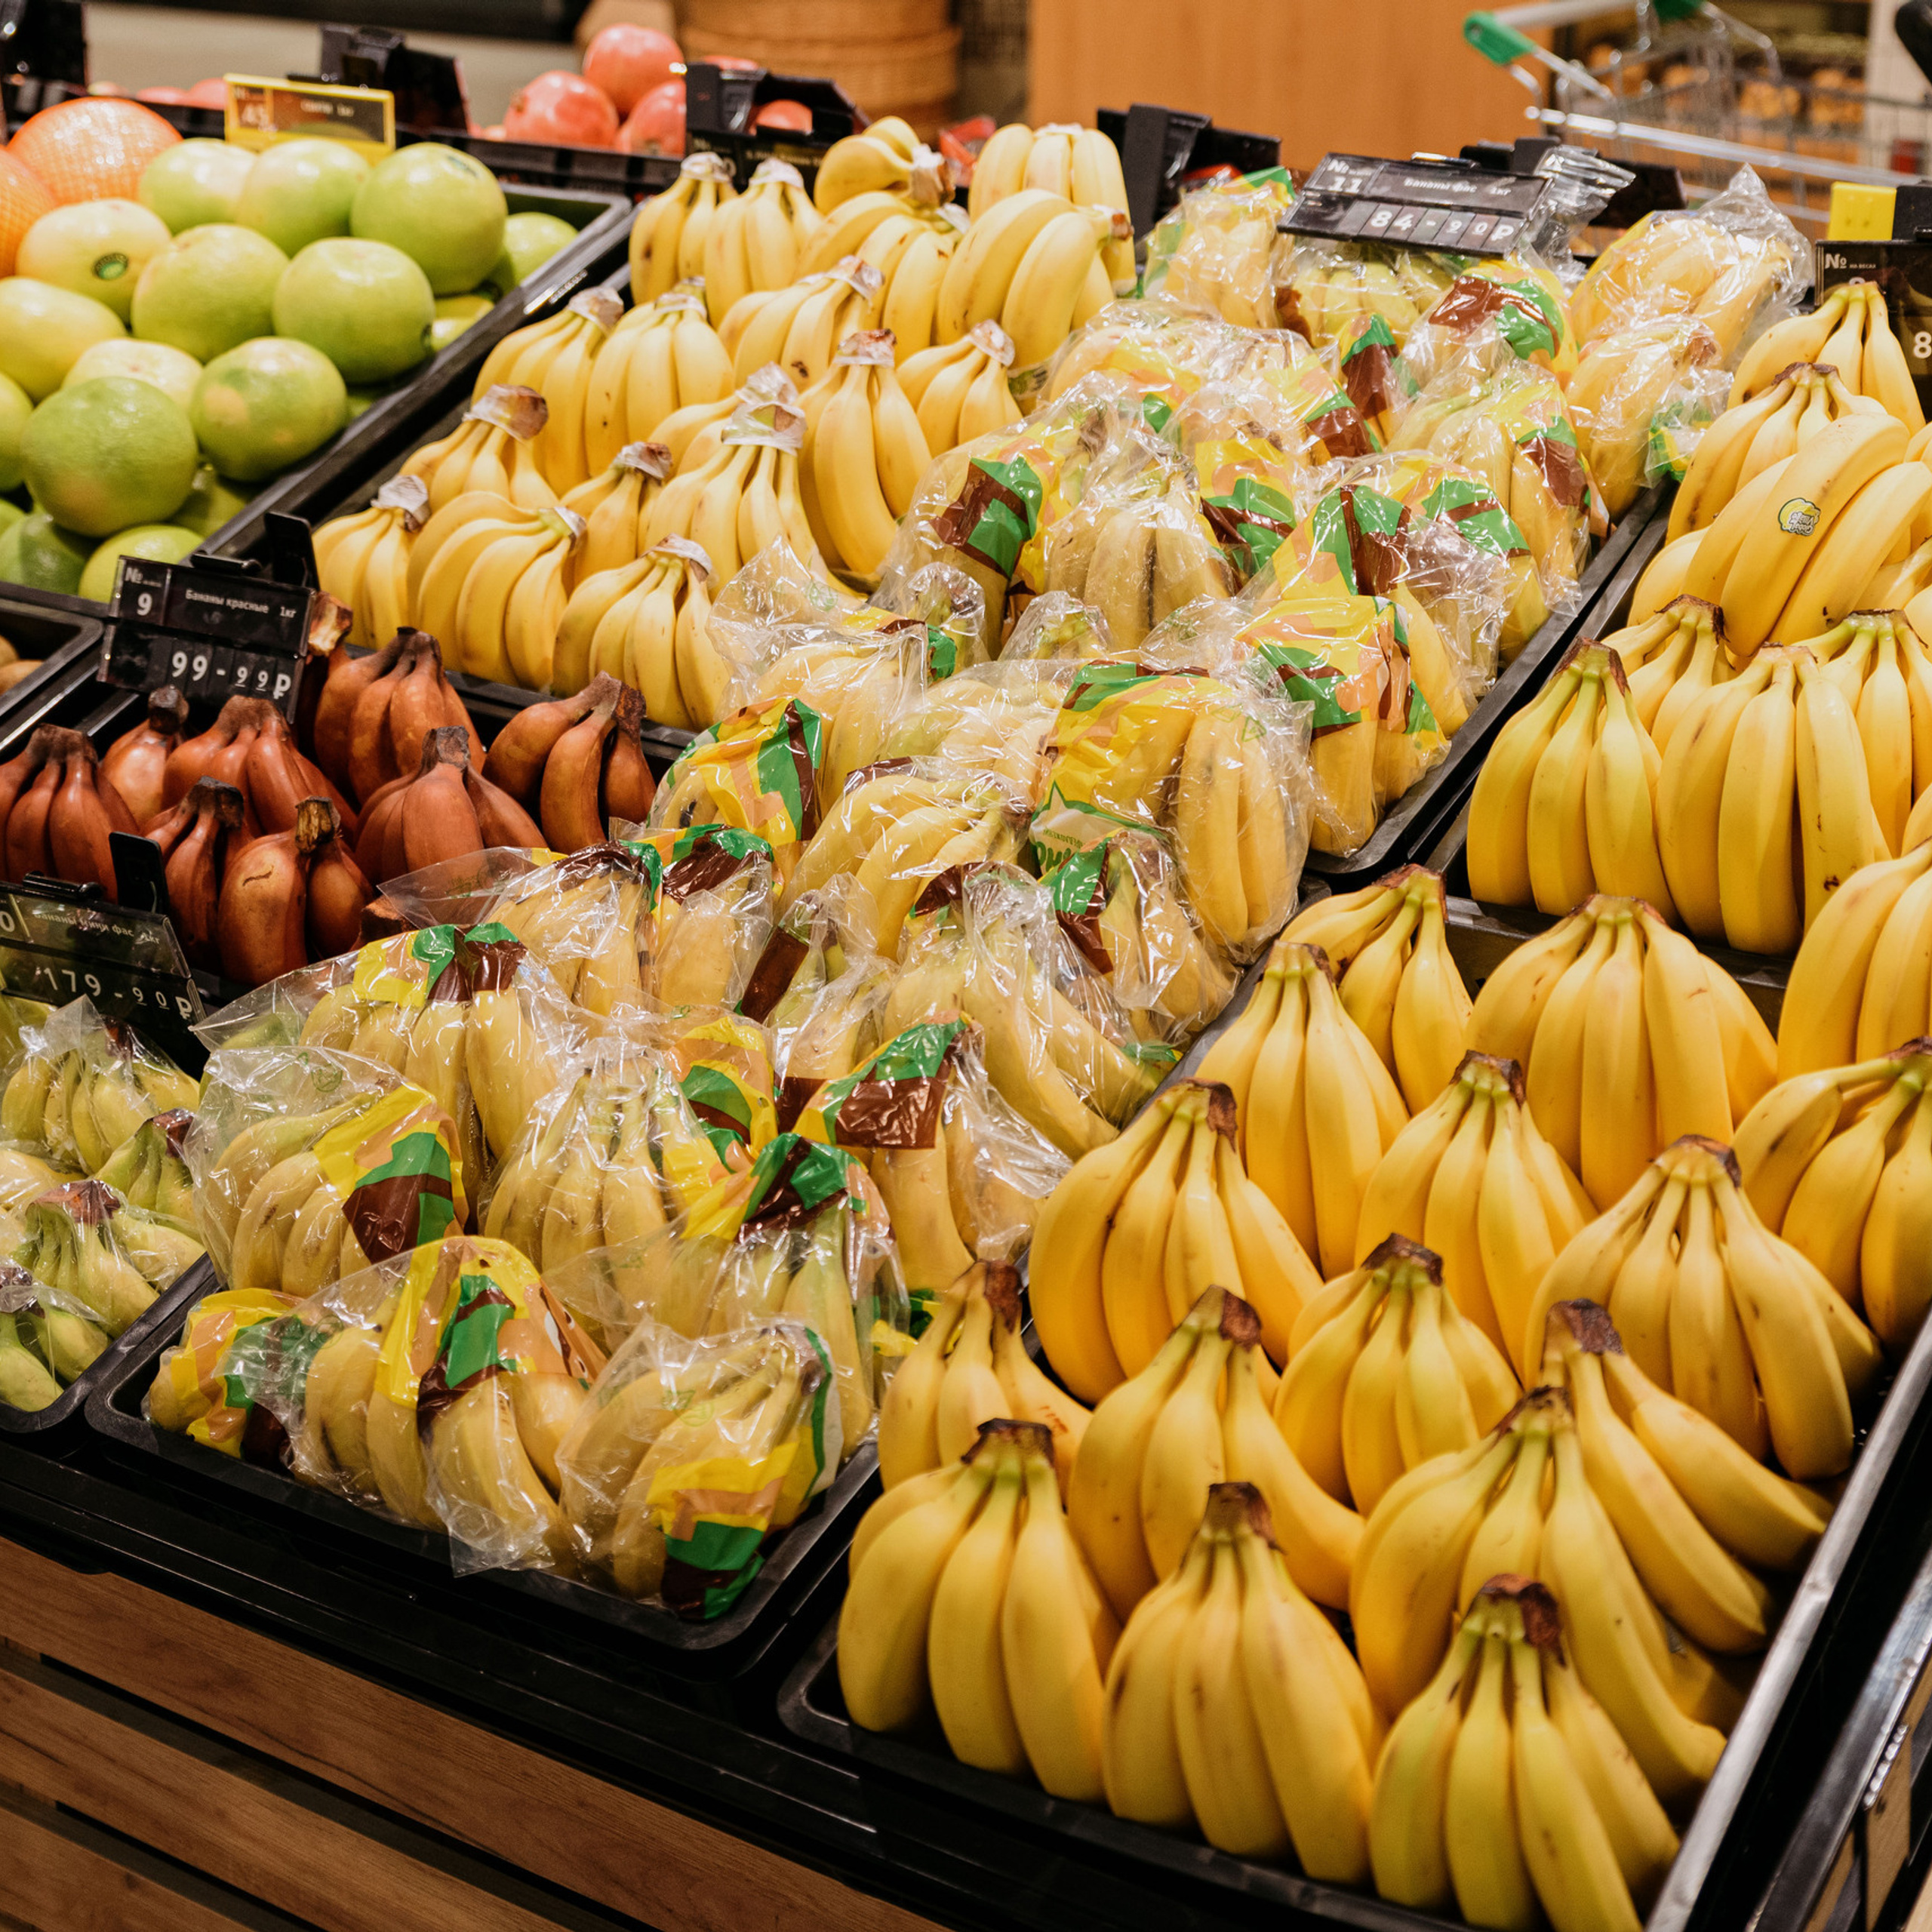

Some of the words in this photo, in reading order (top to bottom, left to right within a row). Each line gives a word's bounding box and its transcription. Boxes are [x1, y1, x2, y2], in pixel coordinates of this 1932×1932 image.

[1327, 176, 1364, 195] 11
[1404, 177, 1451, 191] Бананы
[1825, 252, 1847, 269] №
[125, 566, 143, 585] №
[137, 592, 152, 616] 9
[185, 589, 225, 606] Бананы
[226, 597, 269, 614] красные
[279, 606, 297, 618] 1кг
[112, 923, 134, 938] фас
